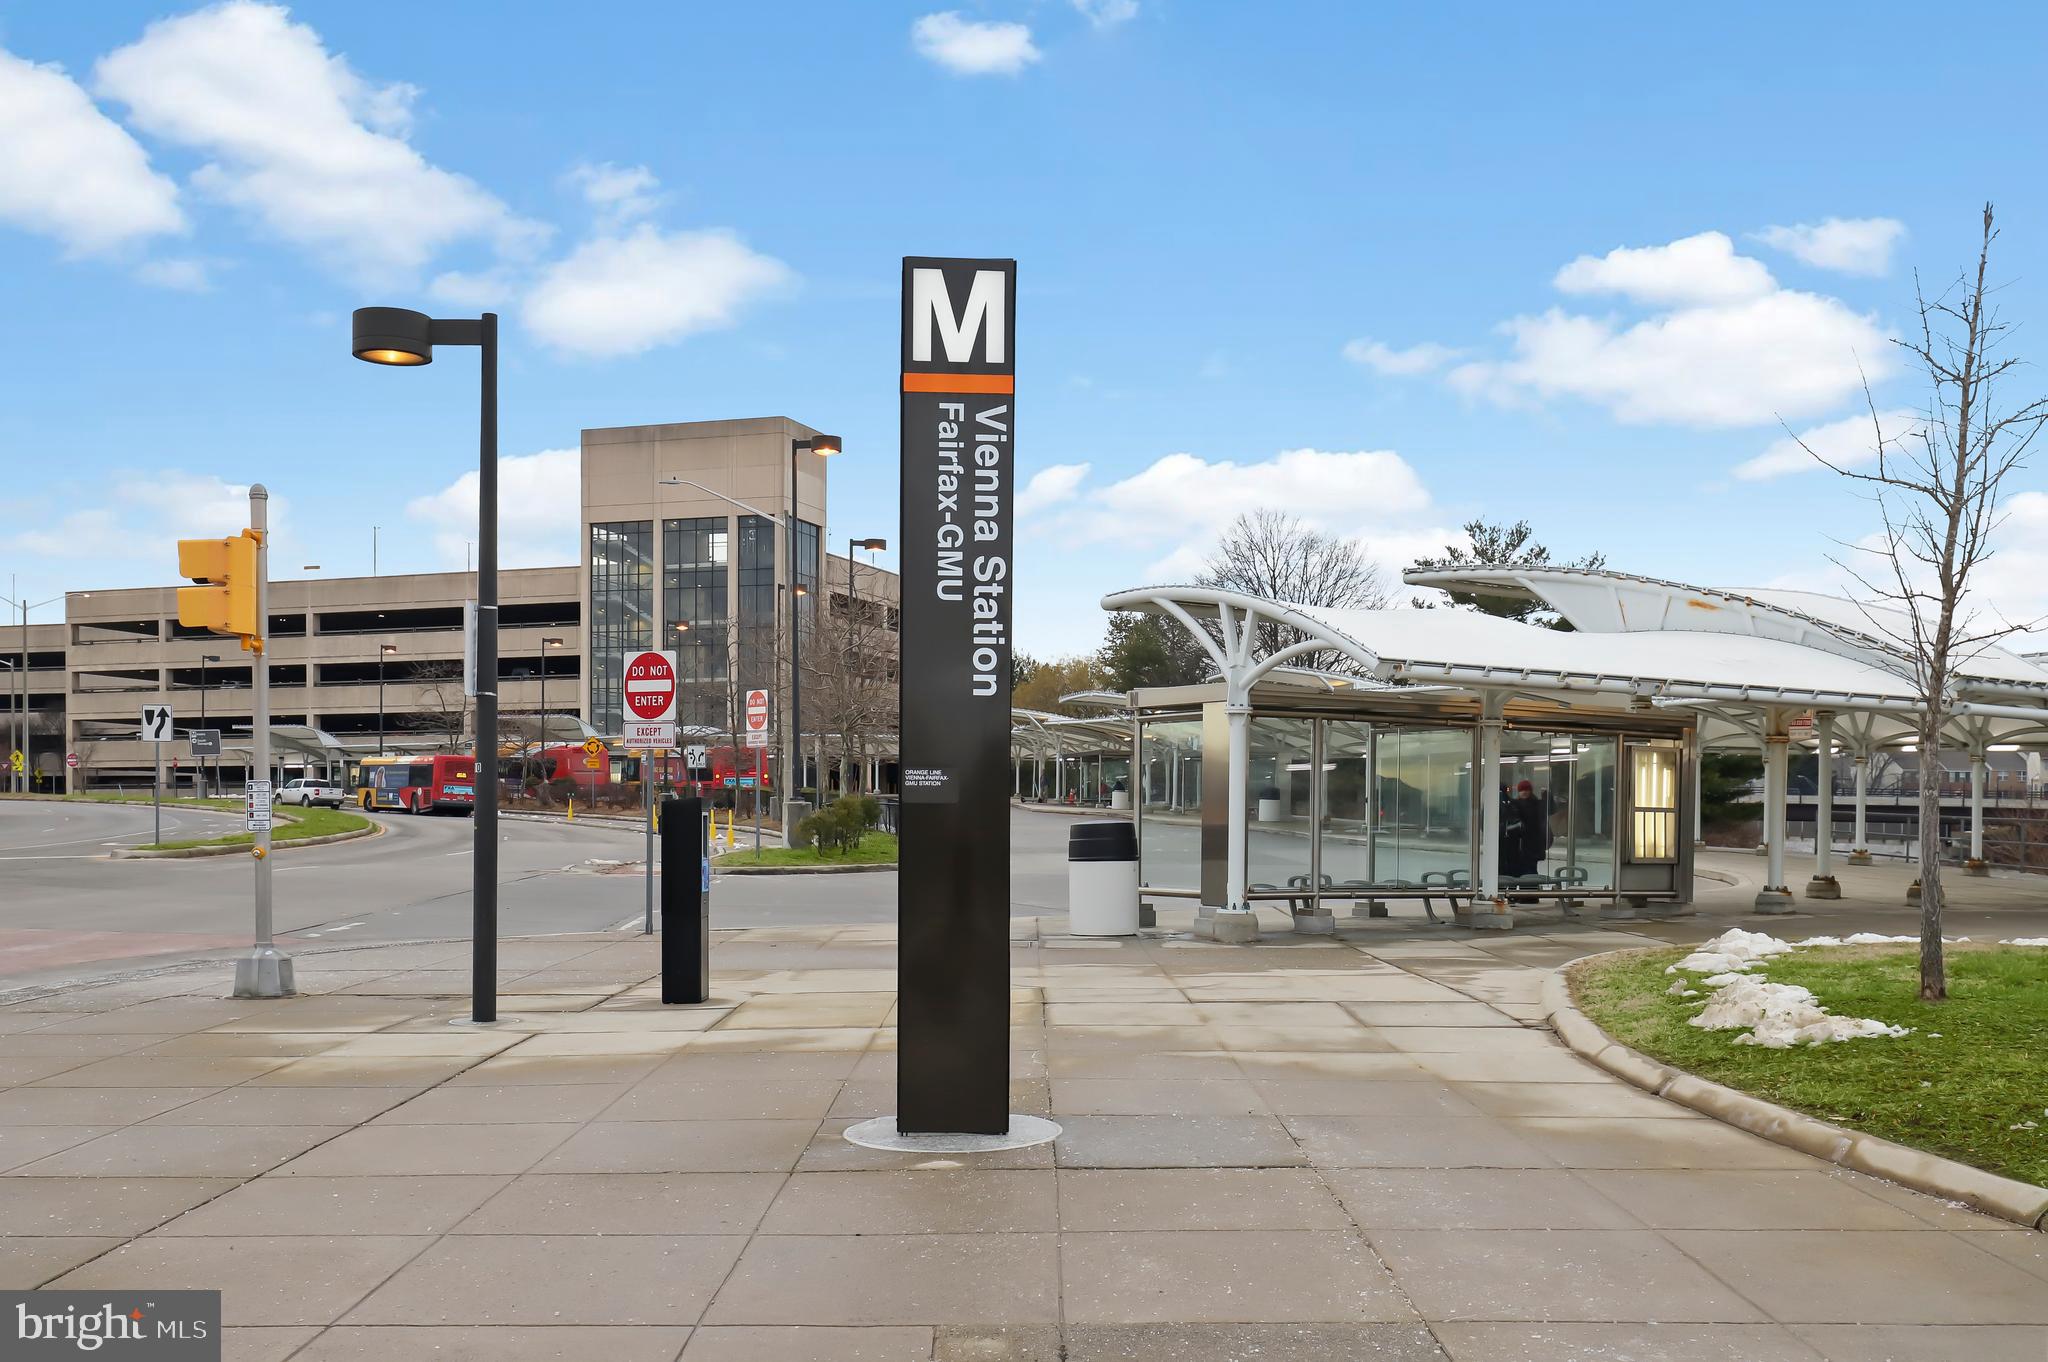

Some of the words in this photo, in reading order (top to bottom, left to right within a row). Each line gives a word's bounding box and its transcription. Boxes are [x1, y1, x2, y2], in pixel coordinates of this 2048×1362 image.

[912, 268, 1006, 364] M
[974, 403, 1008, 543] Vienna
[936, 402, 966, 602] Fairfax-GMU
[971, 556, 1007, 698] Station
[632, 666, 645, 677] DO
[650, 665, 668, 677] NOT
[635, 695, 664, 707] ENTER
[749, 698, 756, 706] DO
[636, 727, 662, 737] EXCEPT
